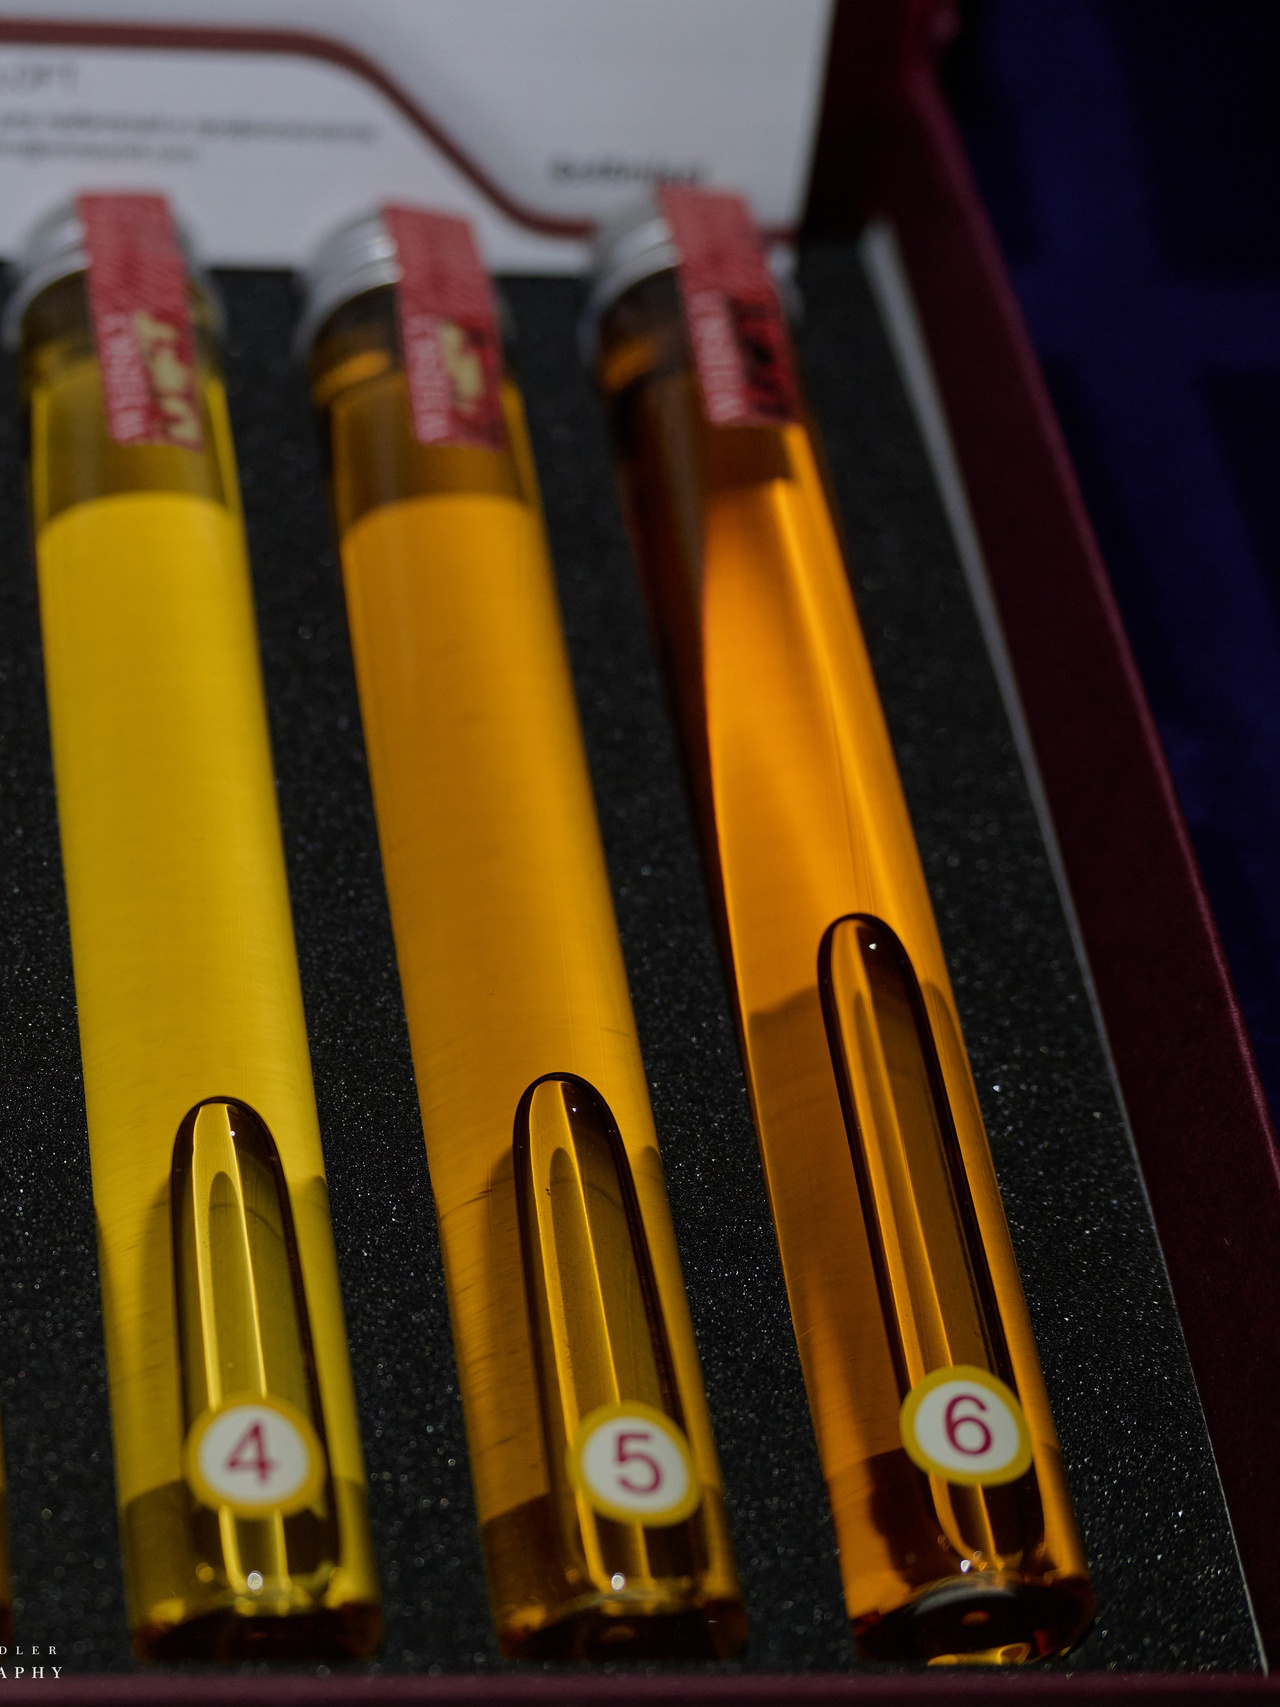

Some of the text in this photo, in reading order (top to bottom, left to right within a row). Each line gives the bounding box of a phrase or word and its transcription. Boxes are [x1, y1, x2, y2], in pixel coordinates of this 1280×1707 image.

[225, 1418, 277, 1484] 4
[944, 1394, 992, 1455] 6
[615, 1432, 664, 1495] 5
